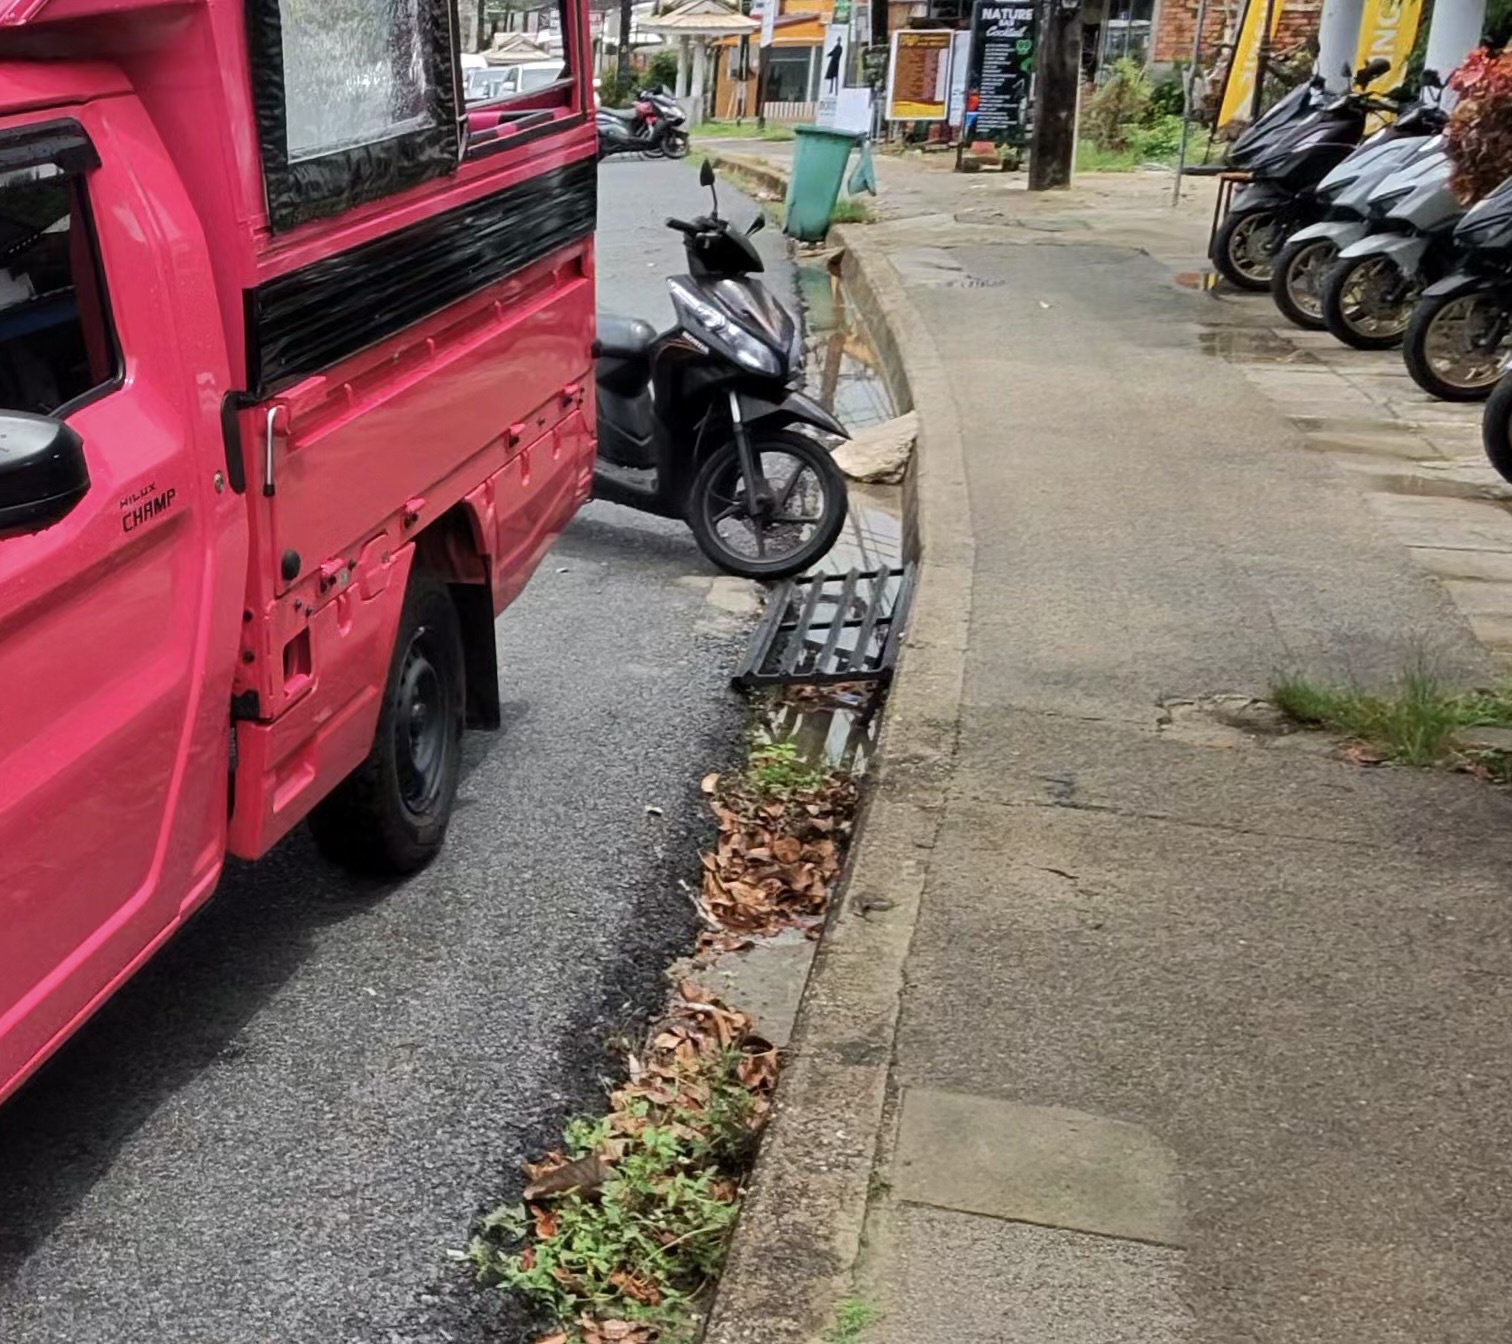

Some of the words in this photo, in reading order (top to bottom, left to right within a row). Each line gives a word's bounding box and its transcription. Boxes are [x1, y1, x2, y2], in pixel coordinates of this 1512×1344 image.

[981, 8, 1034, 20] NATURE
[120, 481, 156, 509] HILUX
[122, 488, 176, 533] CHAMP
